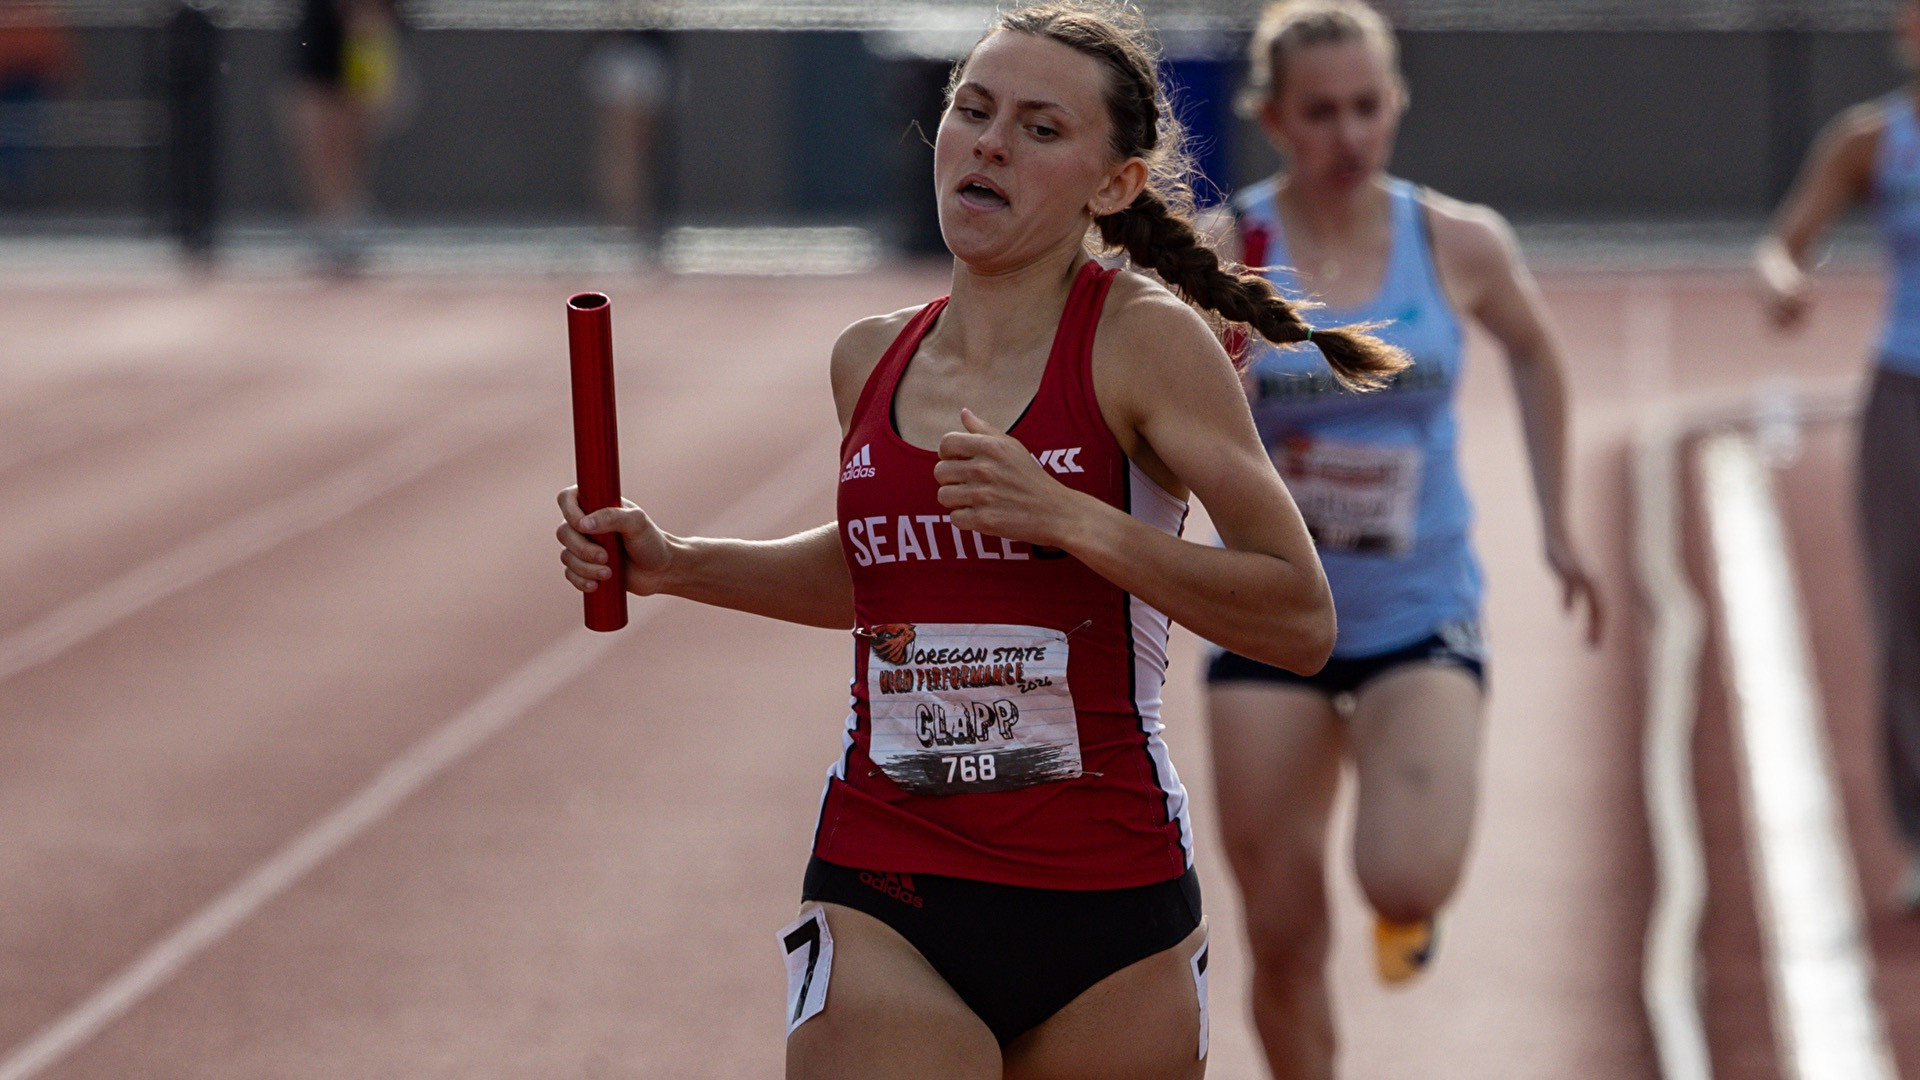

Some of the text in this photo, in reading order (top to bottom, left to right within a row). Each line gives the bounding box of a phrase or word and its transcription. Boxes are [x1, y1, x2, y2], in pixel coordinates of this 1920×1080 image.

[841, 465, 876, 483] adidas
[847, 515, 1068, 567] SEATTLE
[914, 647, 1046, 665] OREGON STATE
[879, 662, 1025, 694] HIGH PERFORMANCE
[915, 699, 1019, 748] CLAPP
[941, 754, 997, 784] 768
[859, 872, 923, 909] adidas
[783, 916, 820, 1025] 7
